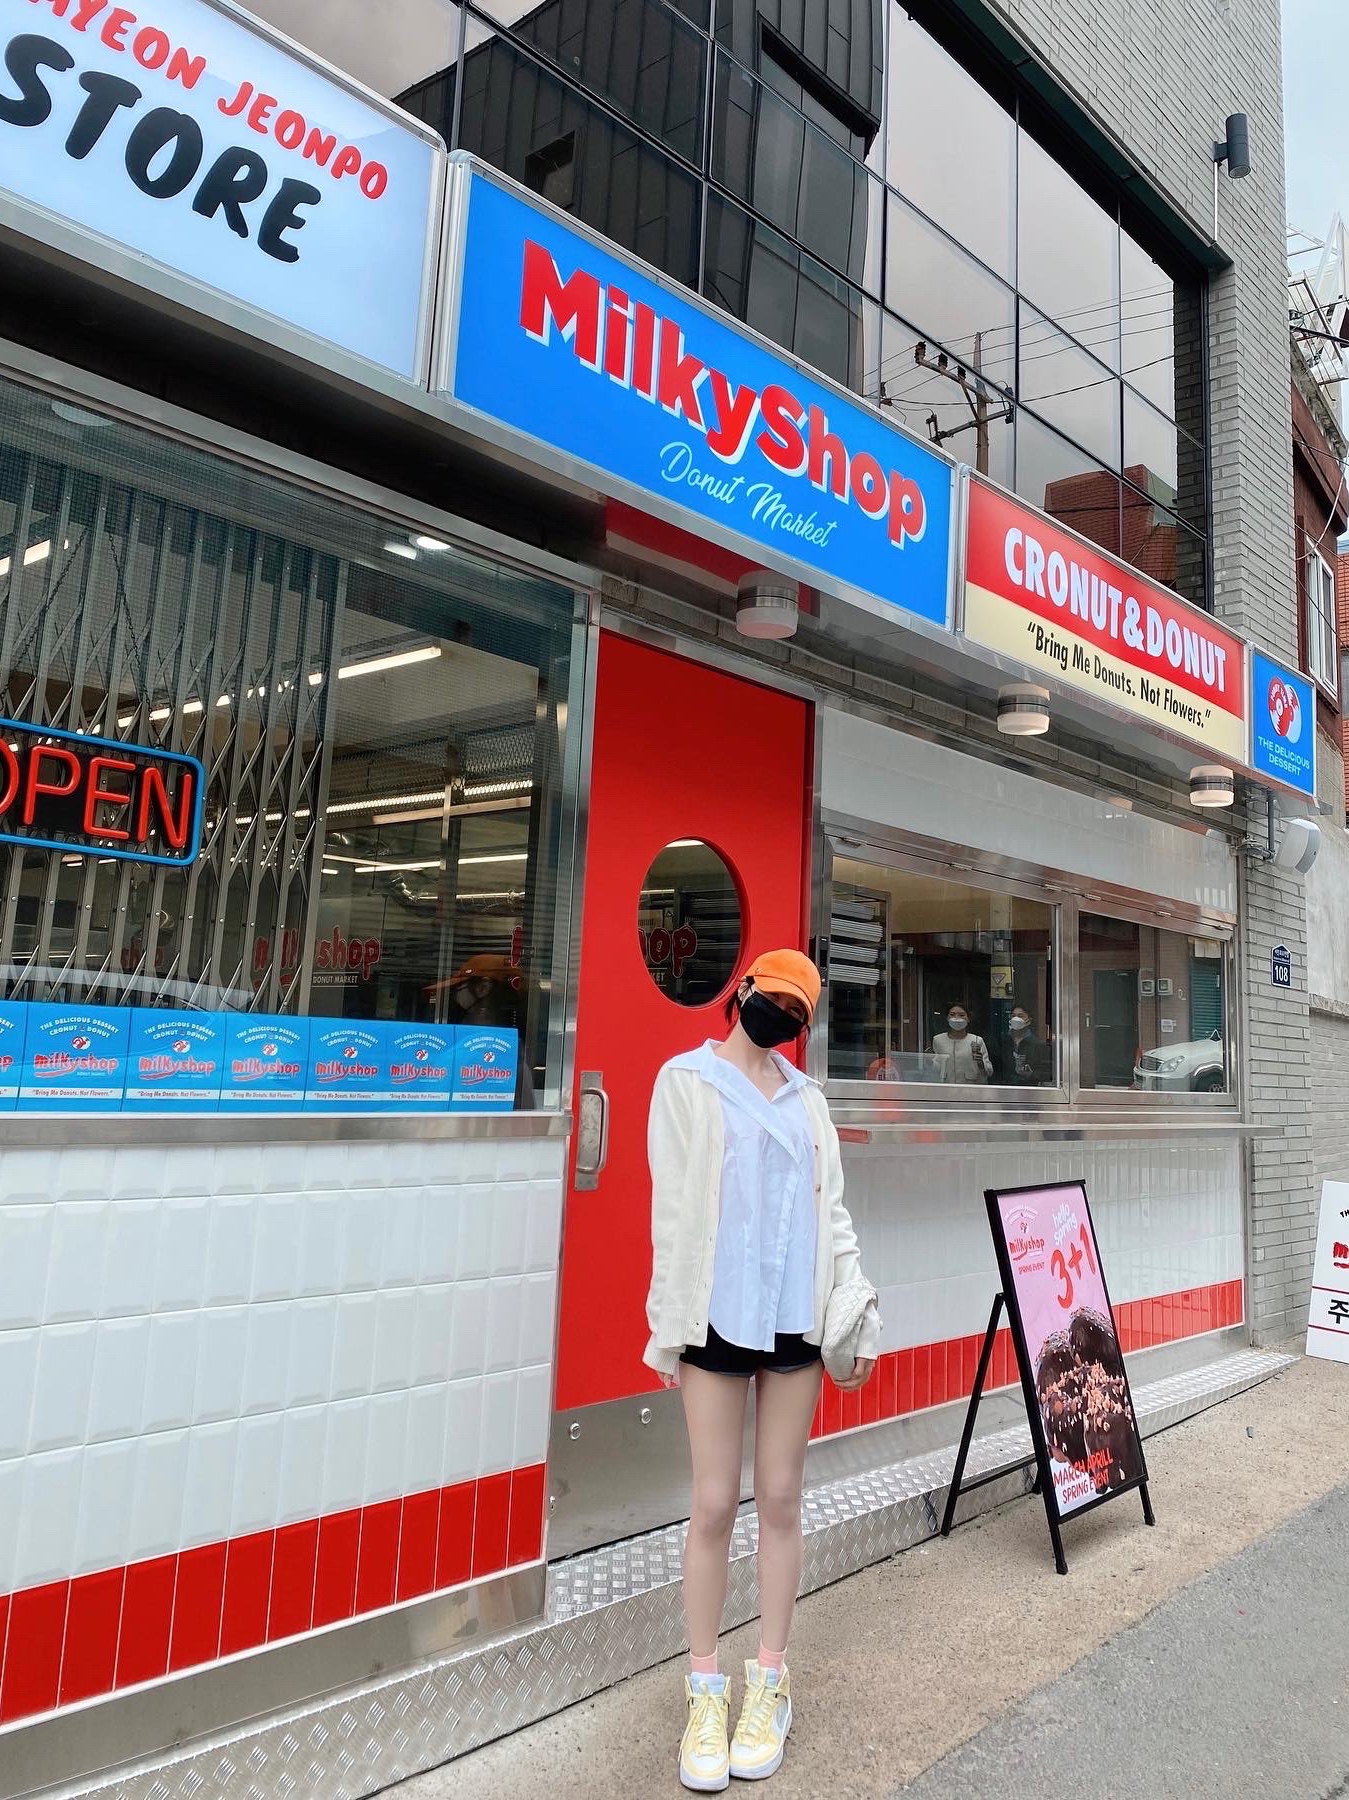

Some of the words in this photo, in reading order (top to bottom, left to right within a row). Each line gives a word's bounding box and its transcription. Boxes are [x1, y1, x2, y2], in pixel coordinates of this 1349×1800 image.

[27, 0, 206, 89] YEON
[217, 81, 388, 199] JEONPO
[0, 33, 321, 264] STORE
[520, 238, 928, 551] MilkyShop
[660, 441, 746, 506] Donut
[746, 482, 838, 548] Market
[1004, 527, 1227, 693] CRONUT&DONUT
[1072, 643, 1091, 674] Me
[1094, 654, 1136, 697] Donuts.
[1140, 677, 1160, 707] Not
[1258, 735, 1274, 752] THE
[1275, 744, 1310, 770] DELICIOUS
[1268, 754, 1301, 776] DESSERT
[313, 976, 333, 984] DONUT
[334, 975, 358, 984] MARKET
[1274, 965, 1289, 982] 108
[40, 1022, 53, 1031] THE
[54, 1017, 91, 1025] DELICIOUS
[92, 1018, 120, 1034] DESSERT
[1051, 1223, 1096, 1309] 3+1
[1053, 1459, 1086, 1488] MARCH
[1062, 1480, 1089, 1505] SPRING
[1089, 1468, 1109, 1491] EVENT
